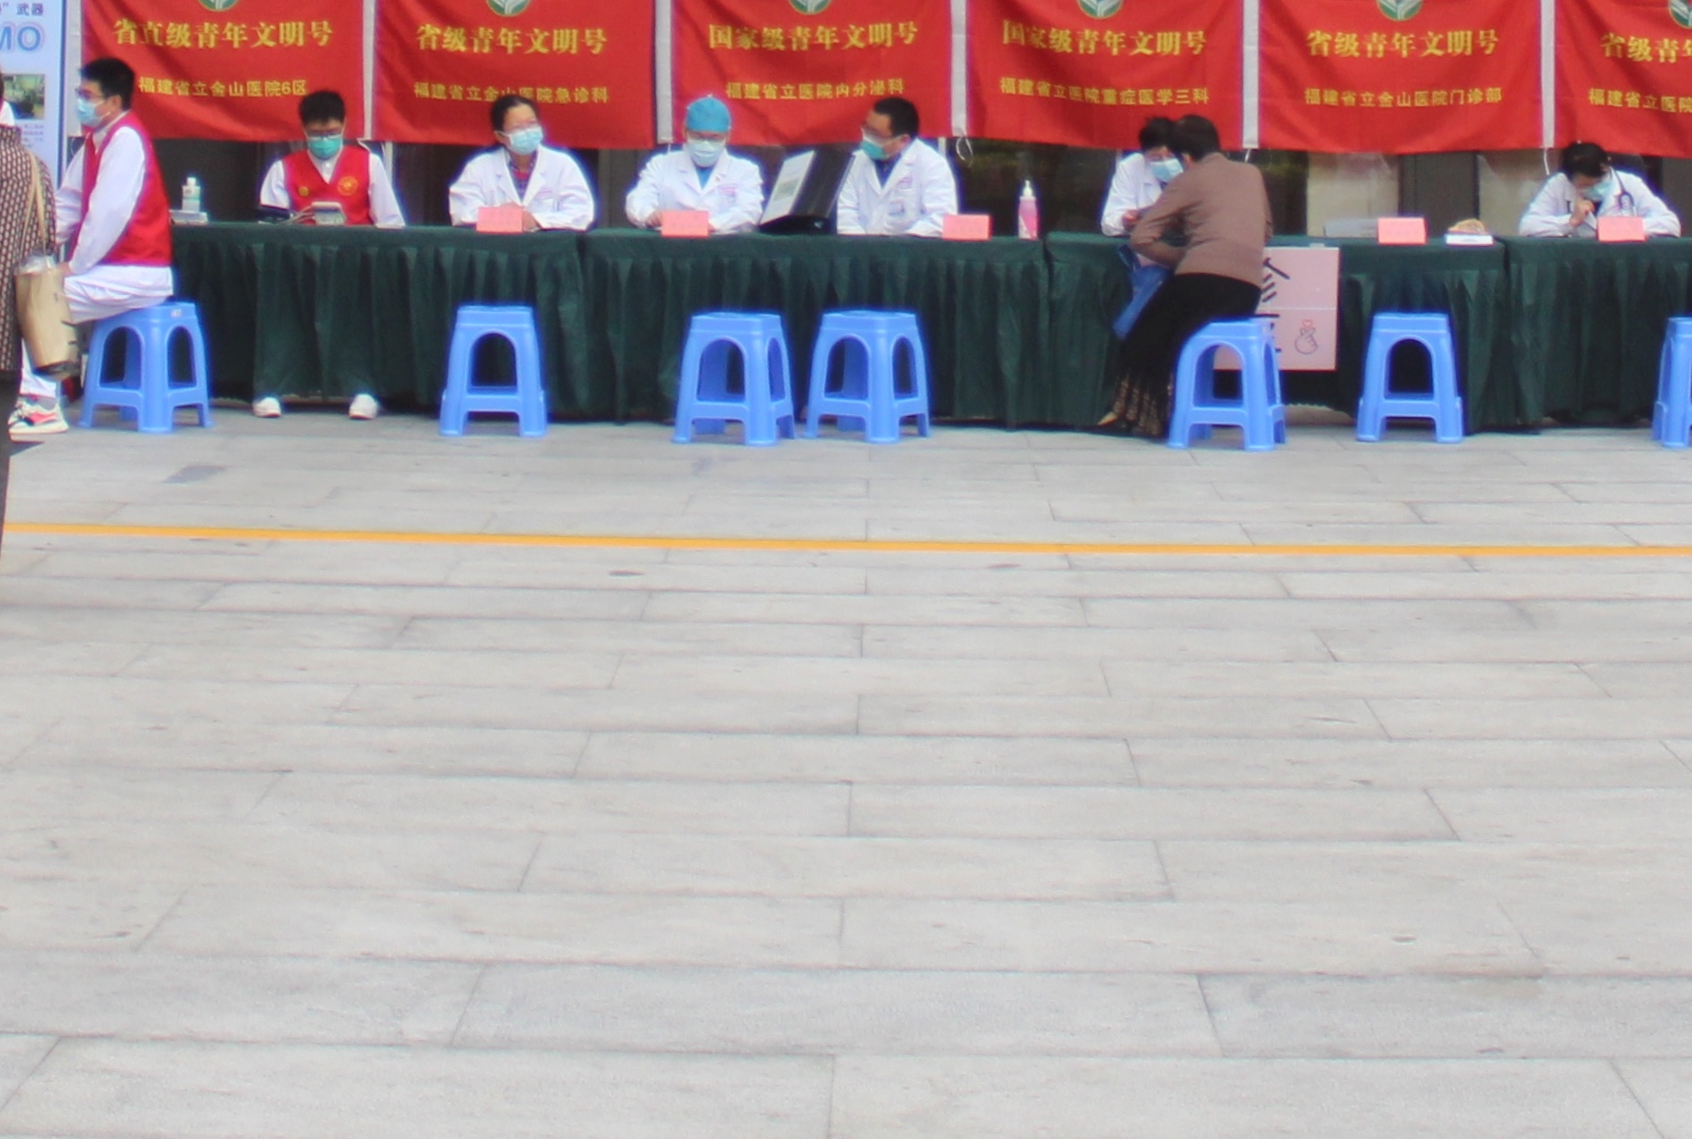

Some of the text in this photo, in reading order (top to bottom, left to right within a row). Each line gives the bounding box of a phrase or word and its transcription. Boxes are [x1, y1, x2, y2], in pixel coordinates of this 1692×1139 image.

[112, 18, 334, 50] 省直级青年文明号
[415, 23, 609, 55] 省级青年文明号
[708, 21, 919, 52] 国家级青年文明号
[1001, 19, 1208, 57] 国家级青年文明号
[1306, 28, 1501, 59] 省级青年文明号
[138, 75, 308, 98] 福建省立金山医院6区
[725, 77, 905, 101] 福建省立医院内分泌科
[1304, 85, 1503, 109] 福建省立金山医院门诊部
